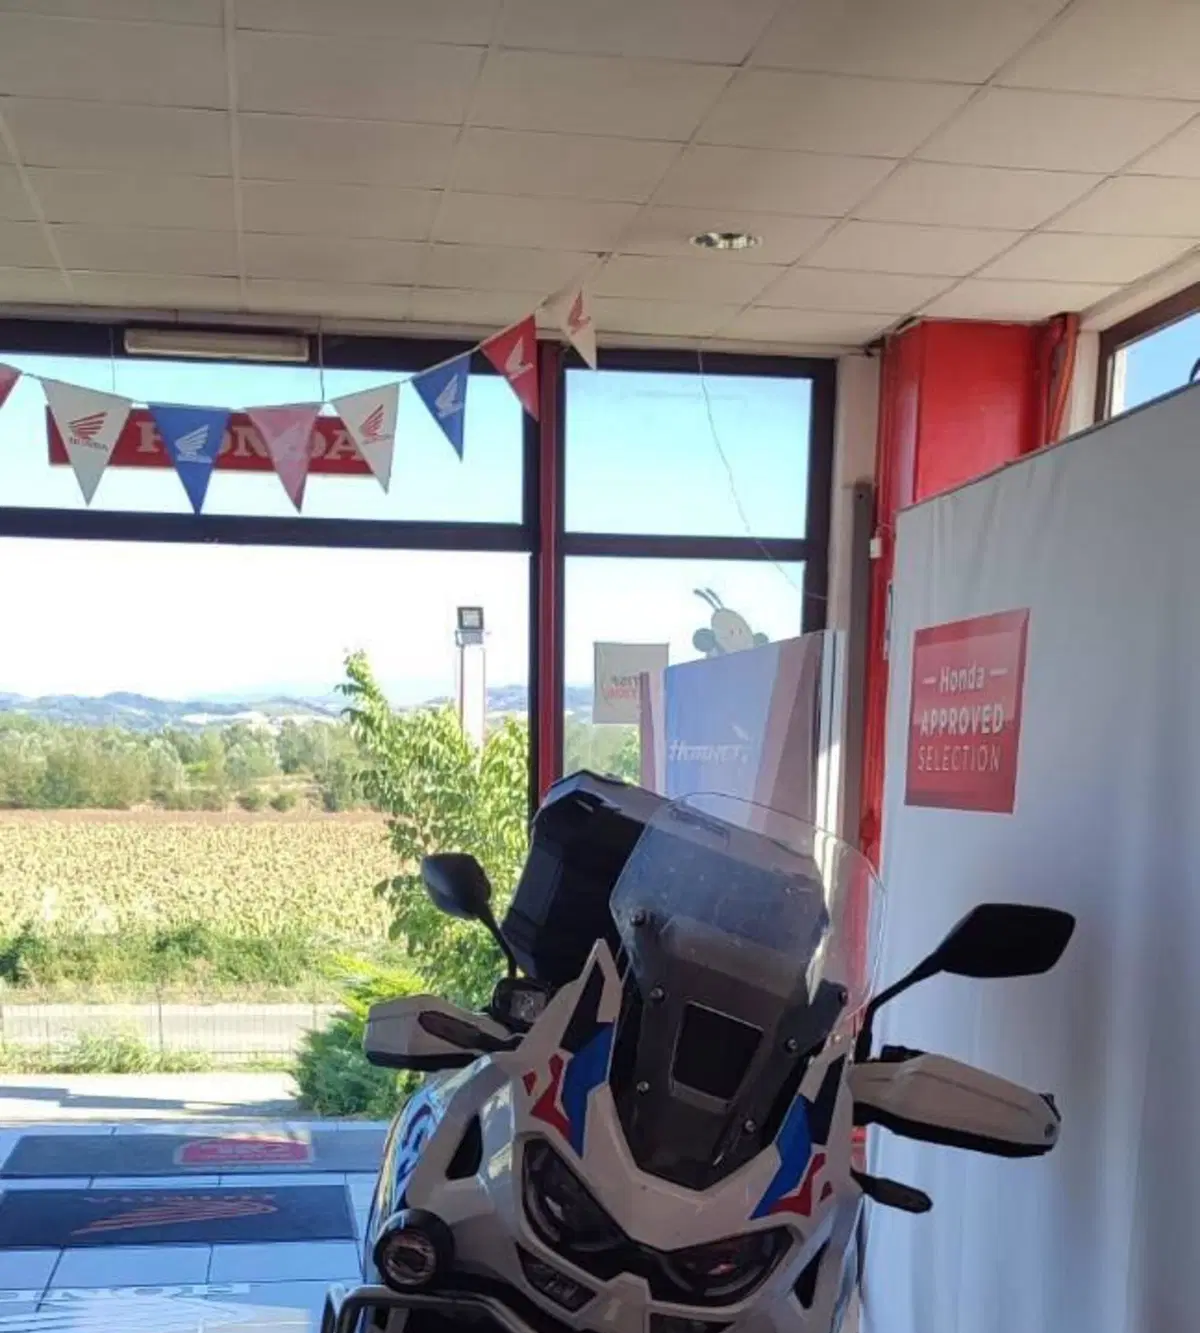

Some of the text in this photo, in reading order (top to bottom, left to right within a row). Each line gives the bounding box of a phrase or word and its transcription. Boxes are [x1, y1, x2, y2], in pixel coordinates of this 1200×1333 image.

[940, 663, 985, 693] Honda
[920, 703, 1004, 740] APPROVED
[918, 745, 1000, 773] SELECTION
